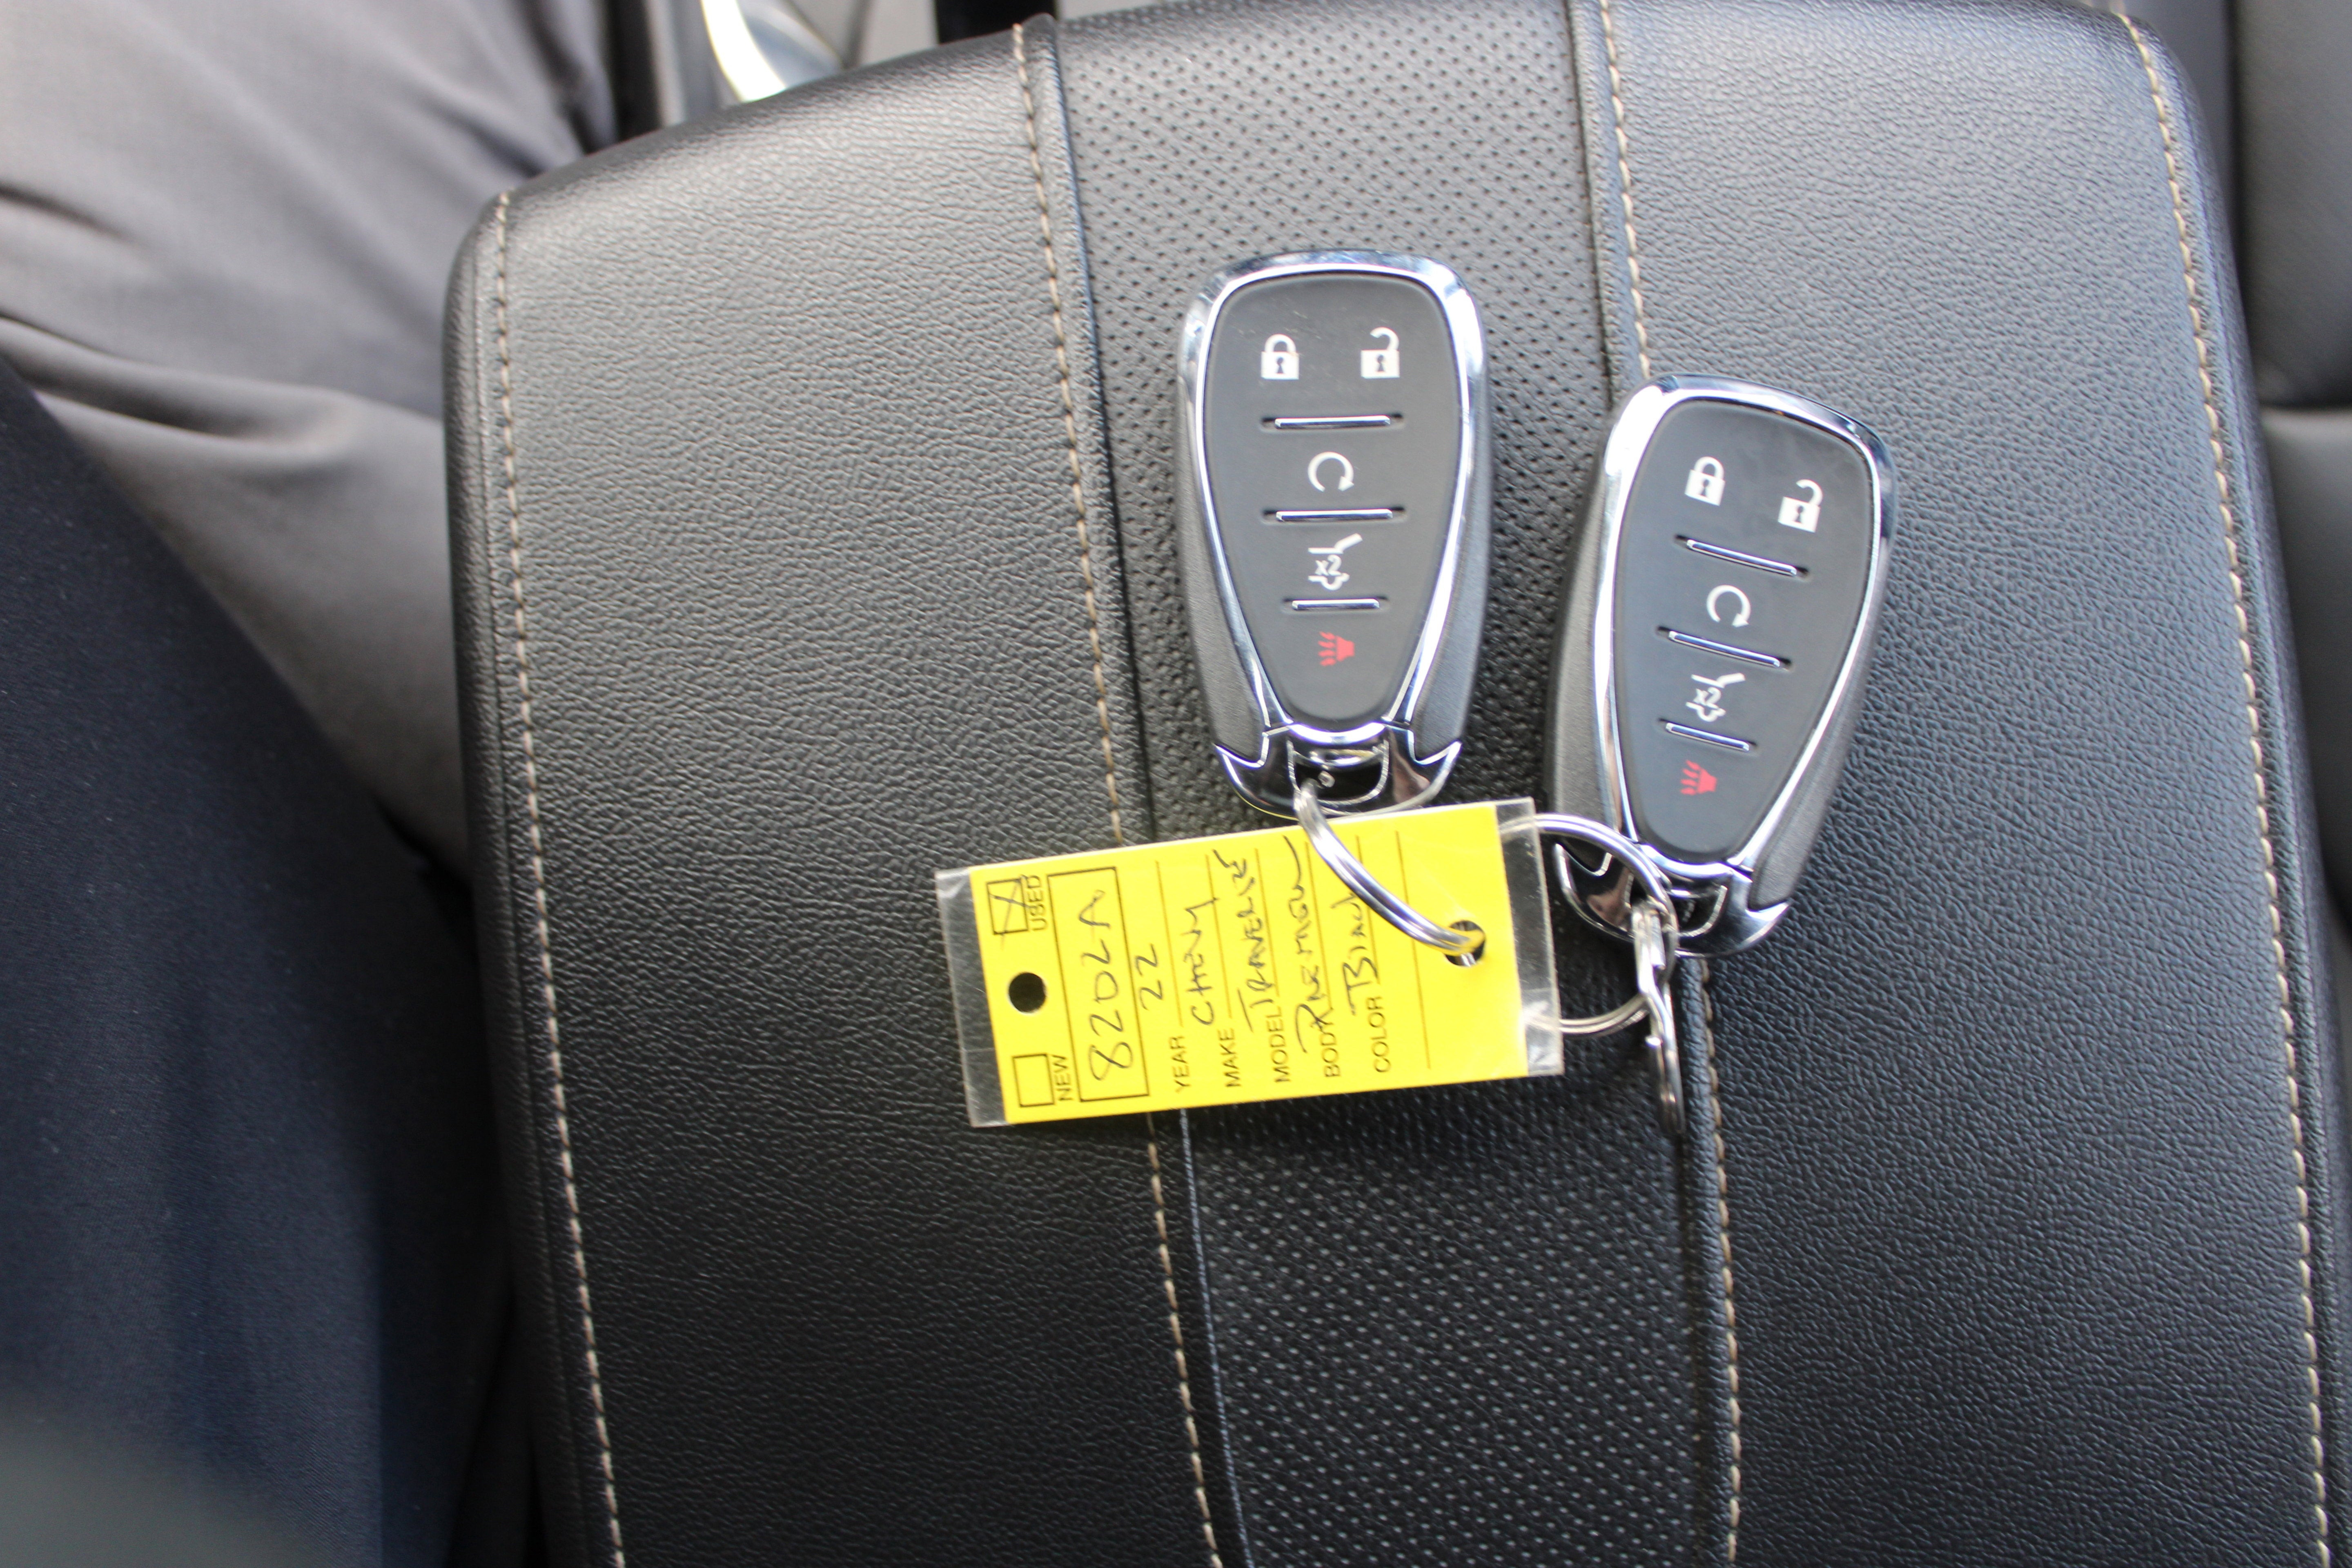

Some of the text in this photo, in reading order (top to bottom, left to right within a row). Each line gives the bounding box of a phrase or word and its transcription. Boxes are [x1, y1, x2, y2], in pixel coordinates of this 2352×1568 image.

[1025, 875, 1048, 931] USED
[1078, 889, 1133, 1081] 8202A
[1134, 944, 1163, 1011] 22
[1168, 1034, 1190, 1093] YEAR
[1217, 1027, 1241, 1087] MAKE
[1265, 1006, 1292, 1083] MODEL
[1317, 1019, 1341, 1078] BODY
[1366, 995, 1392, 1073] COLOR
[1052, 1054, 1073, 1102] NEW
